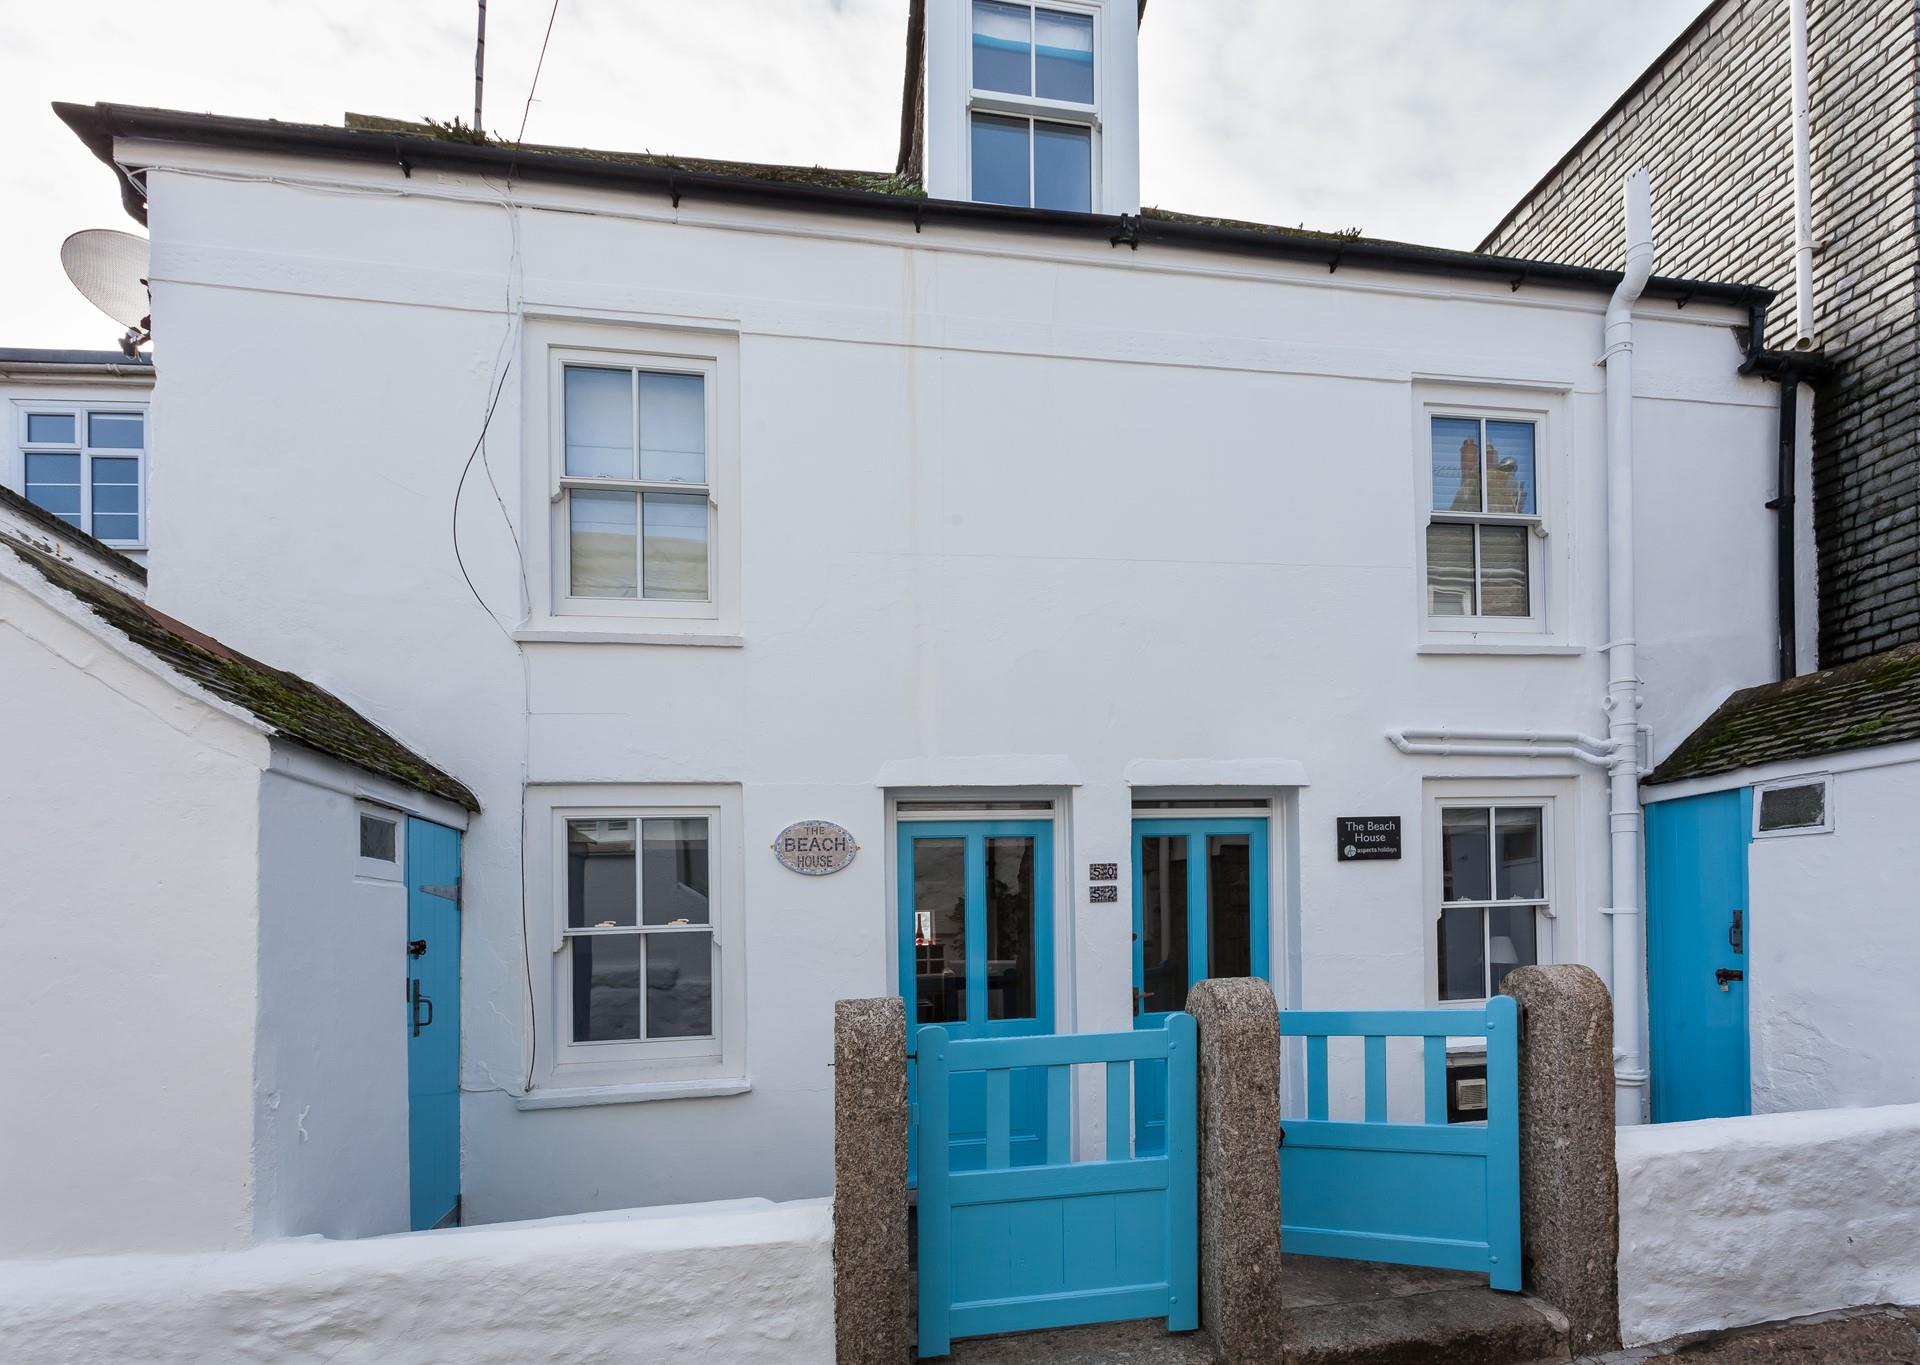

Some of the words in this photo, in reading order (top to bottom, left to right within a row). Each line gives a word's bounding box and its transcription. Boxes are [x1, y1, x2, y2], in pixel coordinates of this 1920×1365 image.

[804, 826, 825, 835] THE
[1345, 821, 1365, 831] The
[1367, 820, 1396, 831] Beach
[1354, 832, 1386, 842] House
[784, 837, 846, 852] BEACH
[797, 855, 833, 868] HOUSE
